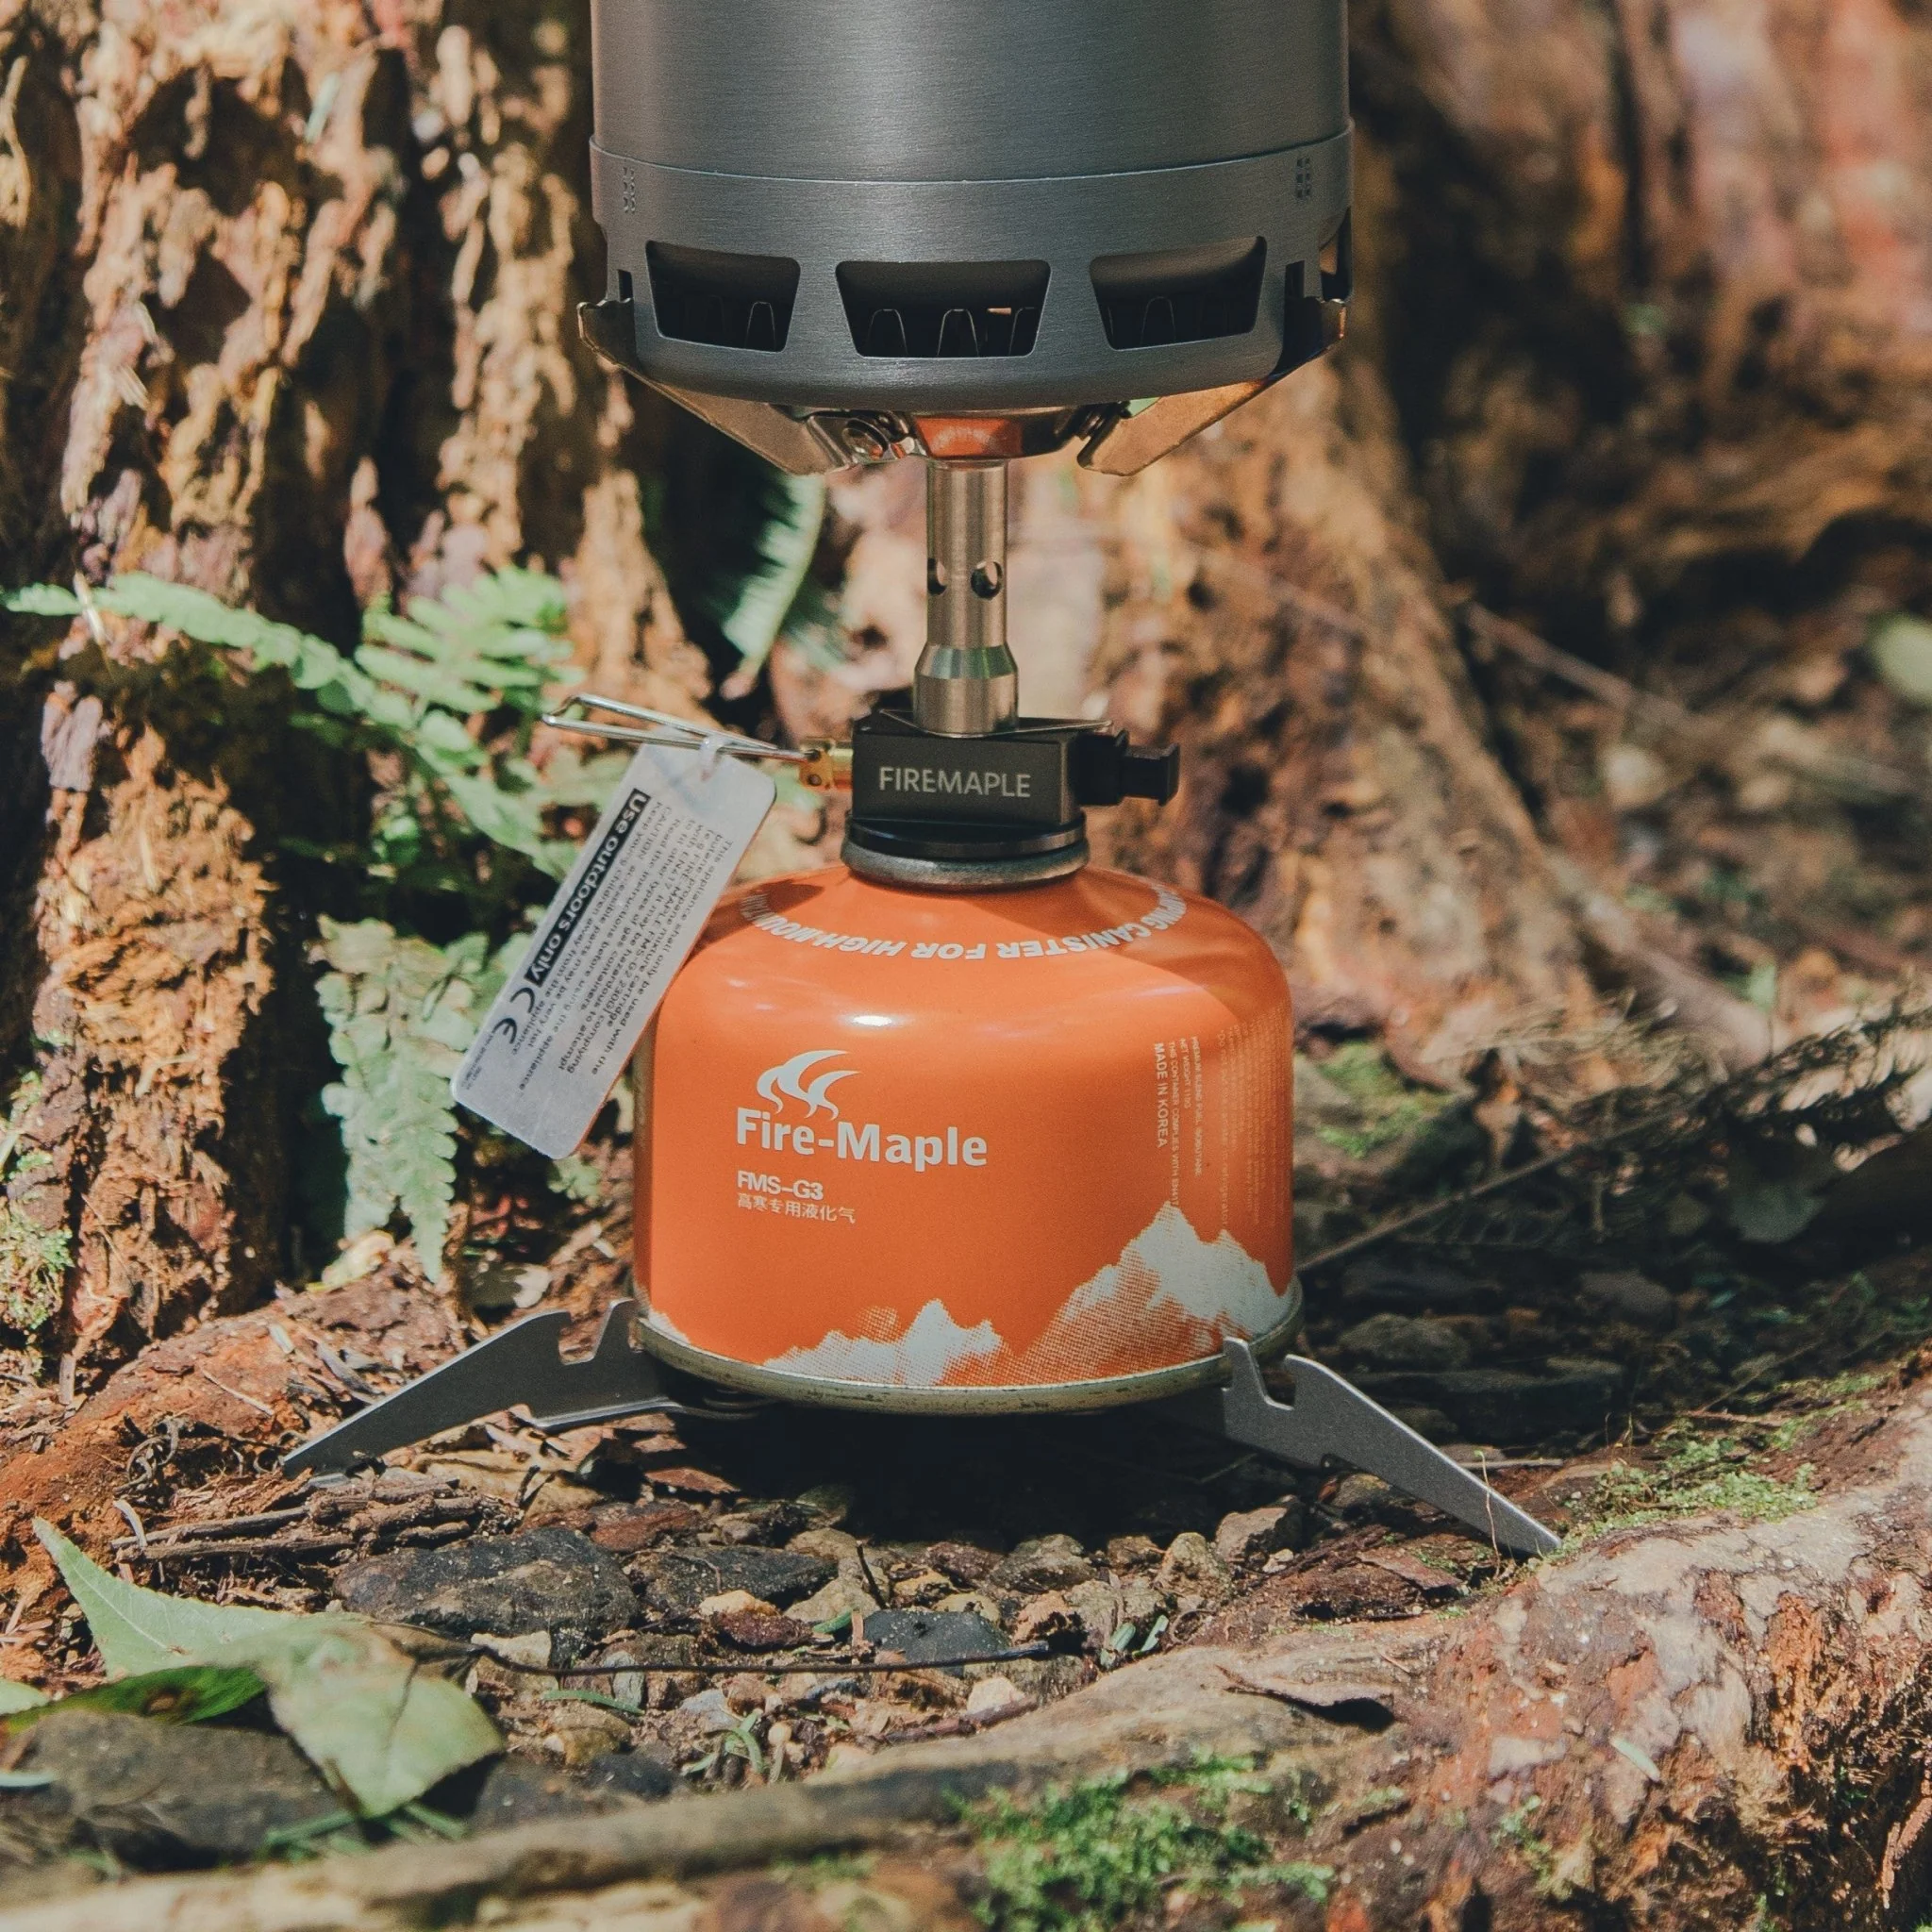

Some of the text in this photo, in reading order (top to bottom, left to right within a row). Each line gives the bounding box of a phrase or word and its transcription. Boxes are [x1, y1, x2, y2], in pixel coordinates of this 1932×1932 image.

[878, 766, 1031, 797] FIREMAPLE
[640, 800, 663, 831] Keep
[618, 831, 644, 868] young
[685, 823, 705, 850] with
[646, 849, 662, 870] the
[657, 846, 679, 877] other
[525, 791, 648, 983] Use outdoors only
[591, 868, 624, 917] children
[598, 864, 638, 924] accessible
[635, 879, 659, 911] types
[606, 870, 650, 940] instructions
[629, 912, 641, 924] of
[637, 904, 657, 930] may
[573, 916, 594, 947] away
[578, 924, 601, 957] parts
[614, 925, 631, 948] gas
[629, 931, 641, 946] be
[996, 922, 1152, 958] CANISTER
[556, 948, 576, 977] from
[583, 941, 609, 978] before
[590, 838, 733, 1076] This appliance shall only be used with the
[638, 927, 669, 974] mixture
[911, 941, 985, 959] FOR
[562, 957, 582, 983] may
[592, 948, 632, 1009] hazardous
[543, 978, 559, 999] the
[554, 985, 567, 1001] be
[562, 978, 586, 1011] using
[604, 974, 641, 1028] cartridge
[491, 982, 541, 1044] CE
[538, 1001, 556, 1025] very
[551, 1013, 566, 1033] the
[584, 1009, 596, 1024] to
[556, 1024, 589, 1071] attempt
[565, 1013, 606, 1074] complying
[1168, 1041, 1176, 1058] THIS
[1179, 1038, 1189, 1053] NET
[1170, 1059, 1179, 1106] CONTAINER
[1182, 1055, 1191, 1086] WEIGHT
[1154, 1042, 1168, 1147] MADE IN KOREA
[736, 1107, 987, 1172] Fire-Maple
[1171, 1108, 1179, 1152] COMPLIES
[1171, 1154, 1179, 1176] WITH
[737, 1170, 824, 1200] FMS-G3
[738, 1192, 856, 1224] 高寒专用液化气
